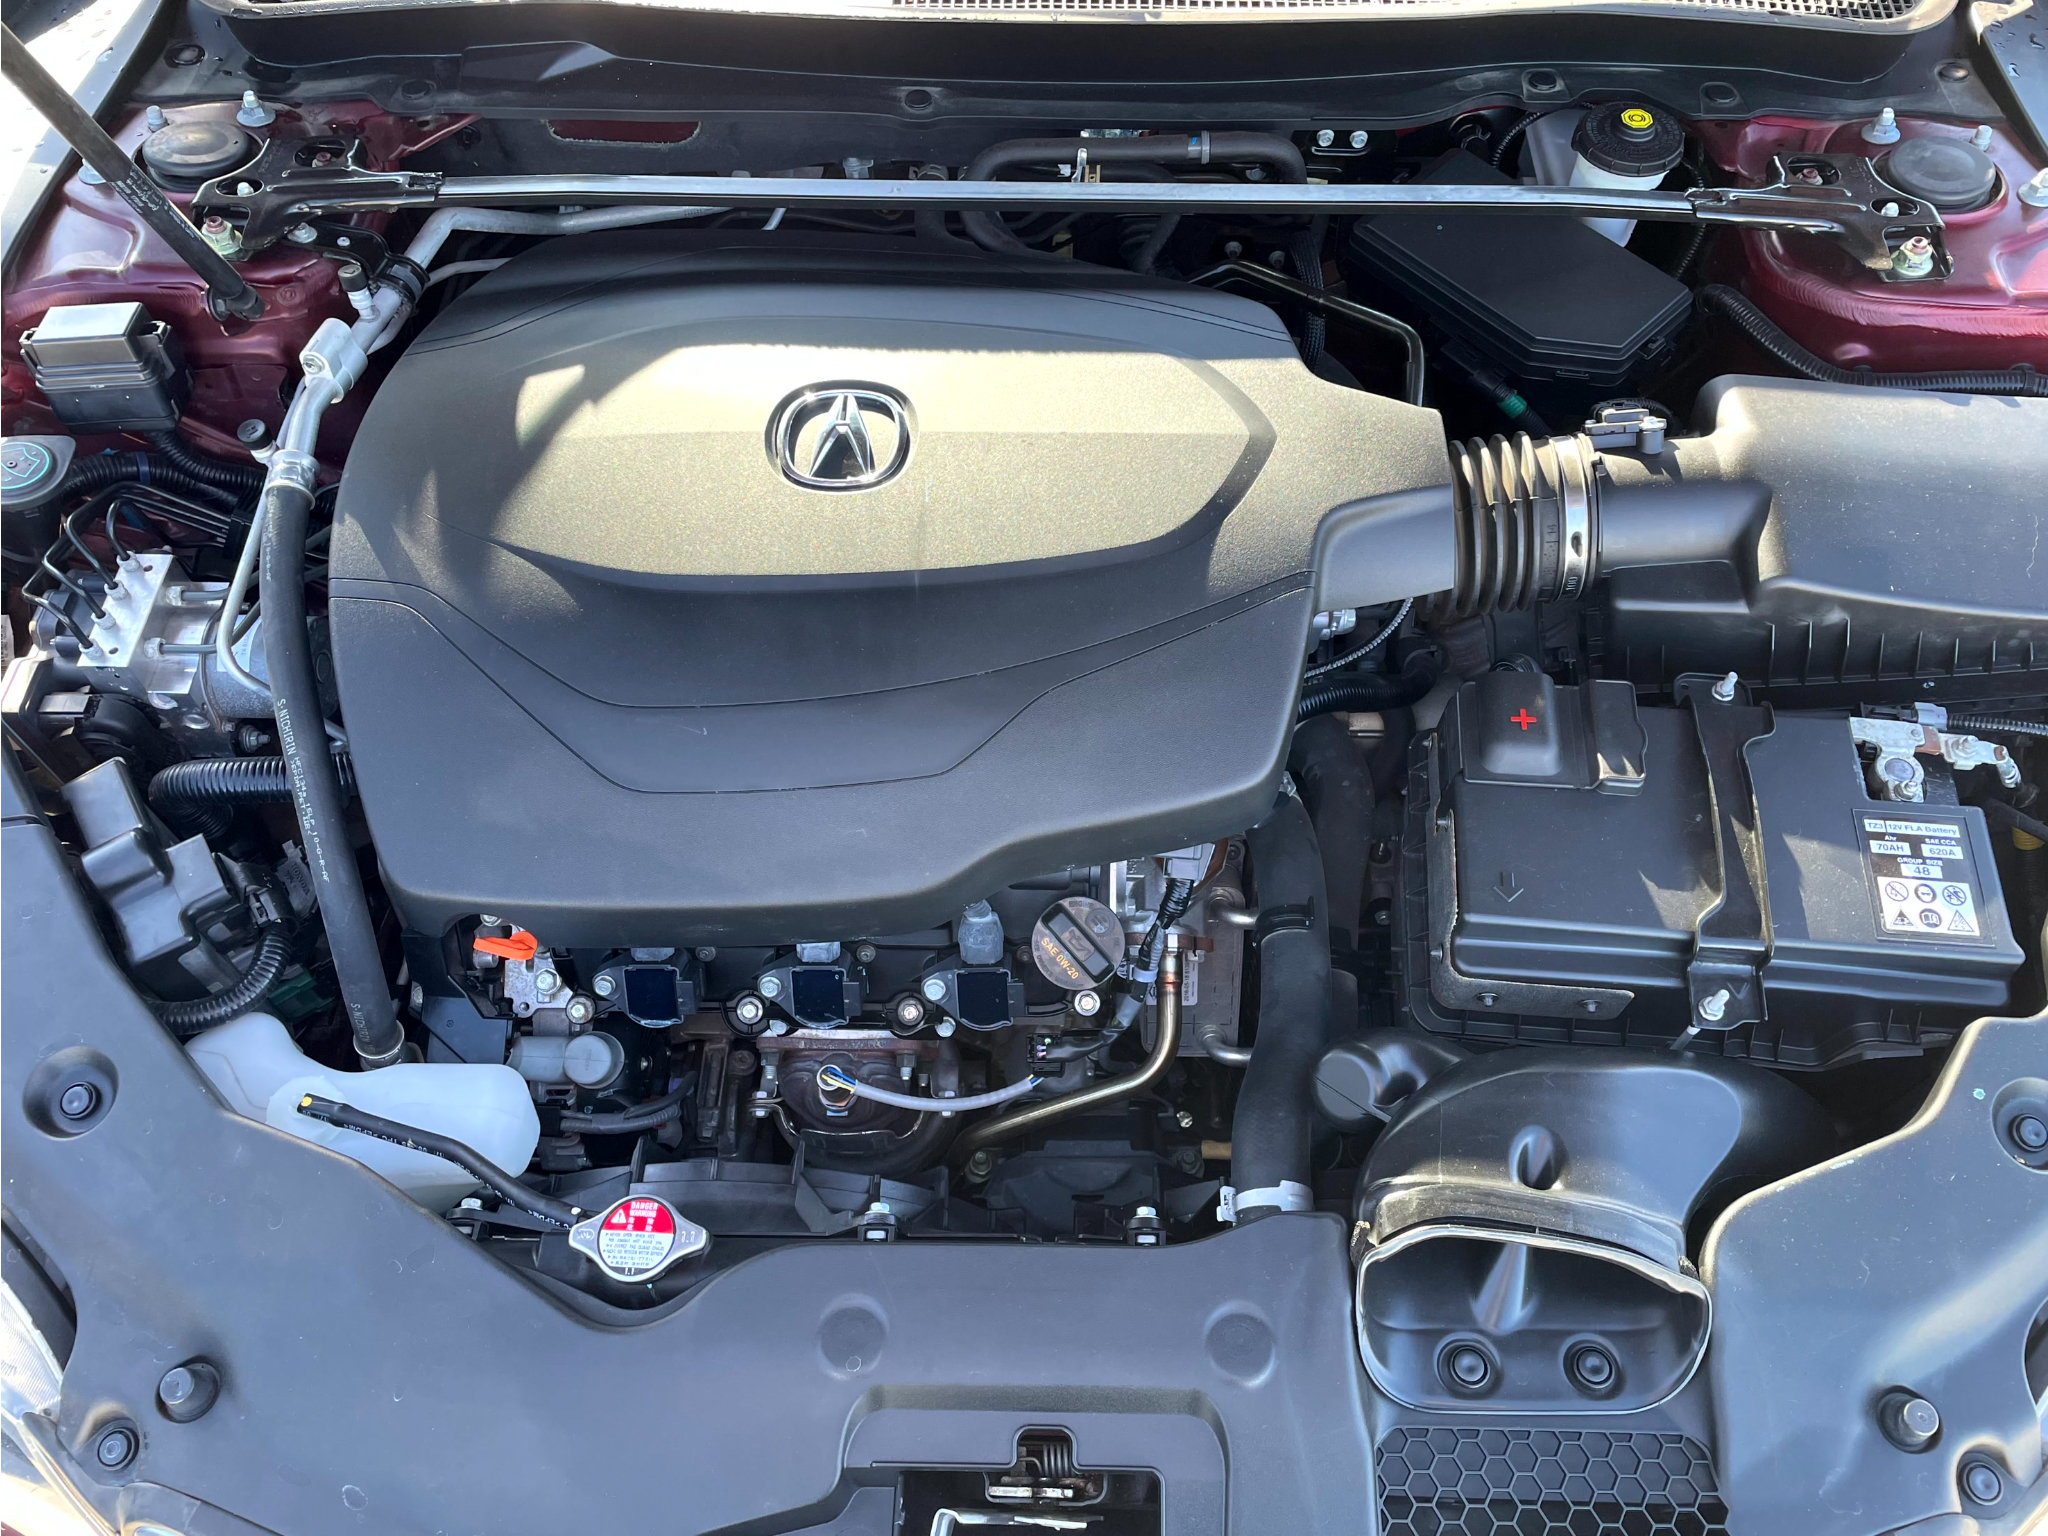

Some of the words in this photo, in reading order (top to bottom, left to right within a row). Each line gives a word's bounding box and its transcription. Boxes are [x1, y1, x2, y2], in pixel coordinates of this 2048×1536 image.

[1888, 823, 1902, 831] 12V
[1904, 824, 1923, 832] FLA
[1924, 826, 1957, 836] Battery
[1876, 843, 1905, 852] 70AH
[1929, 848, 1957, 856] 620A
[1913, 866, 1931, 876] 48
[1041, 937, 1059, 956] SAE
[630, 1201, 659, 1210] DANGER
